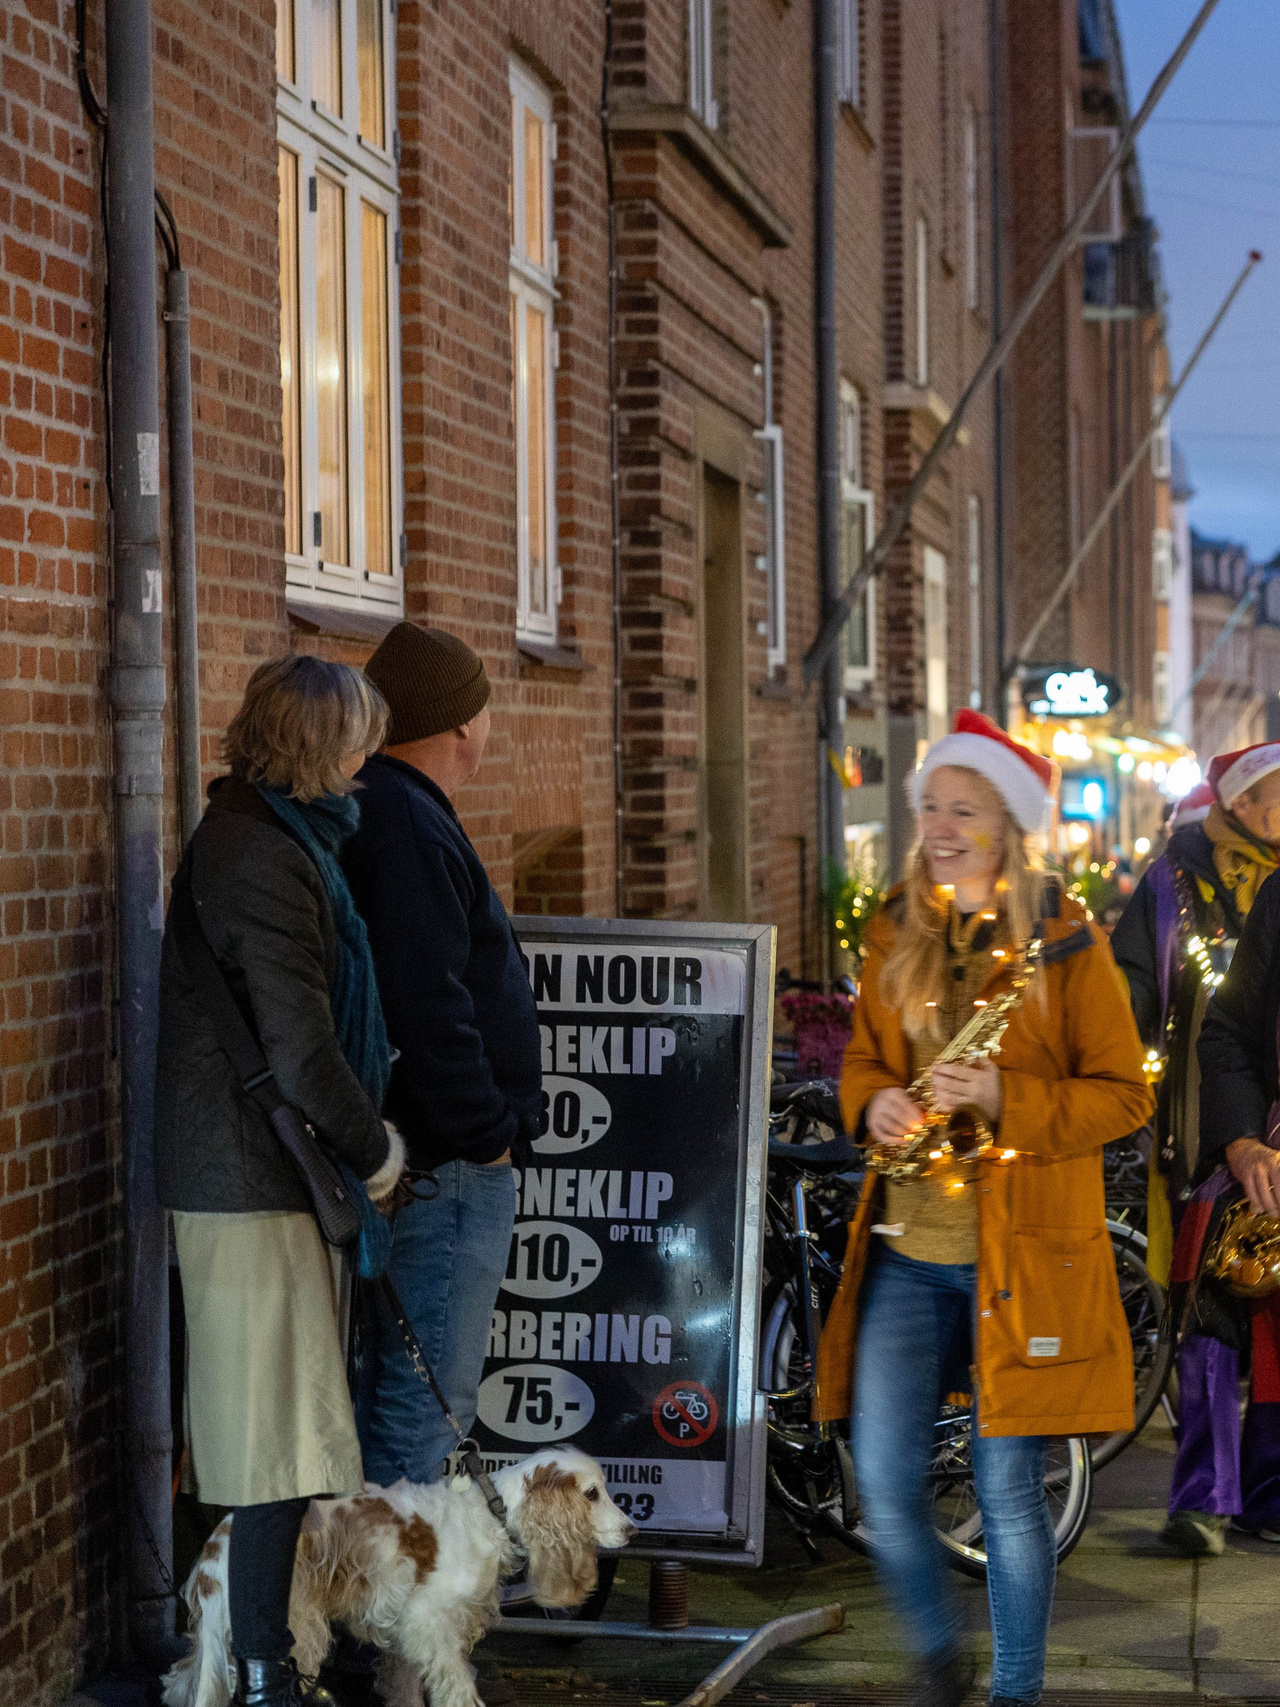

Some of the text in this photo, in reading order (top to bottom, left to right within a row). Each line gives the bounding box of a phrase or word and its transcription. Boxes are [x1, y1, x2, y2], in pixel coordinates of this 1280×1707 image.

[576, 954, 702, 1006] NOUR
[609, 1223, 696, 1244] OP TIL 10 ÅR
[503, 1376, 580, 1431] 75,-
[679, 1422, 690, 1438] P
